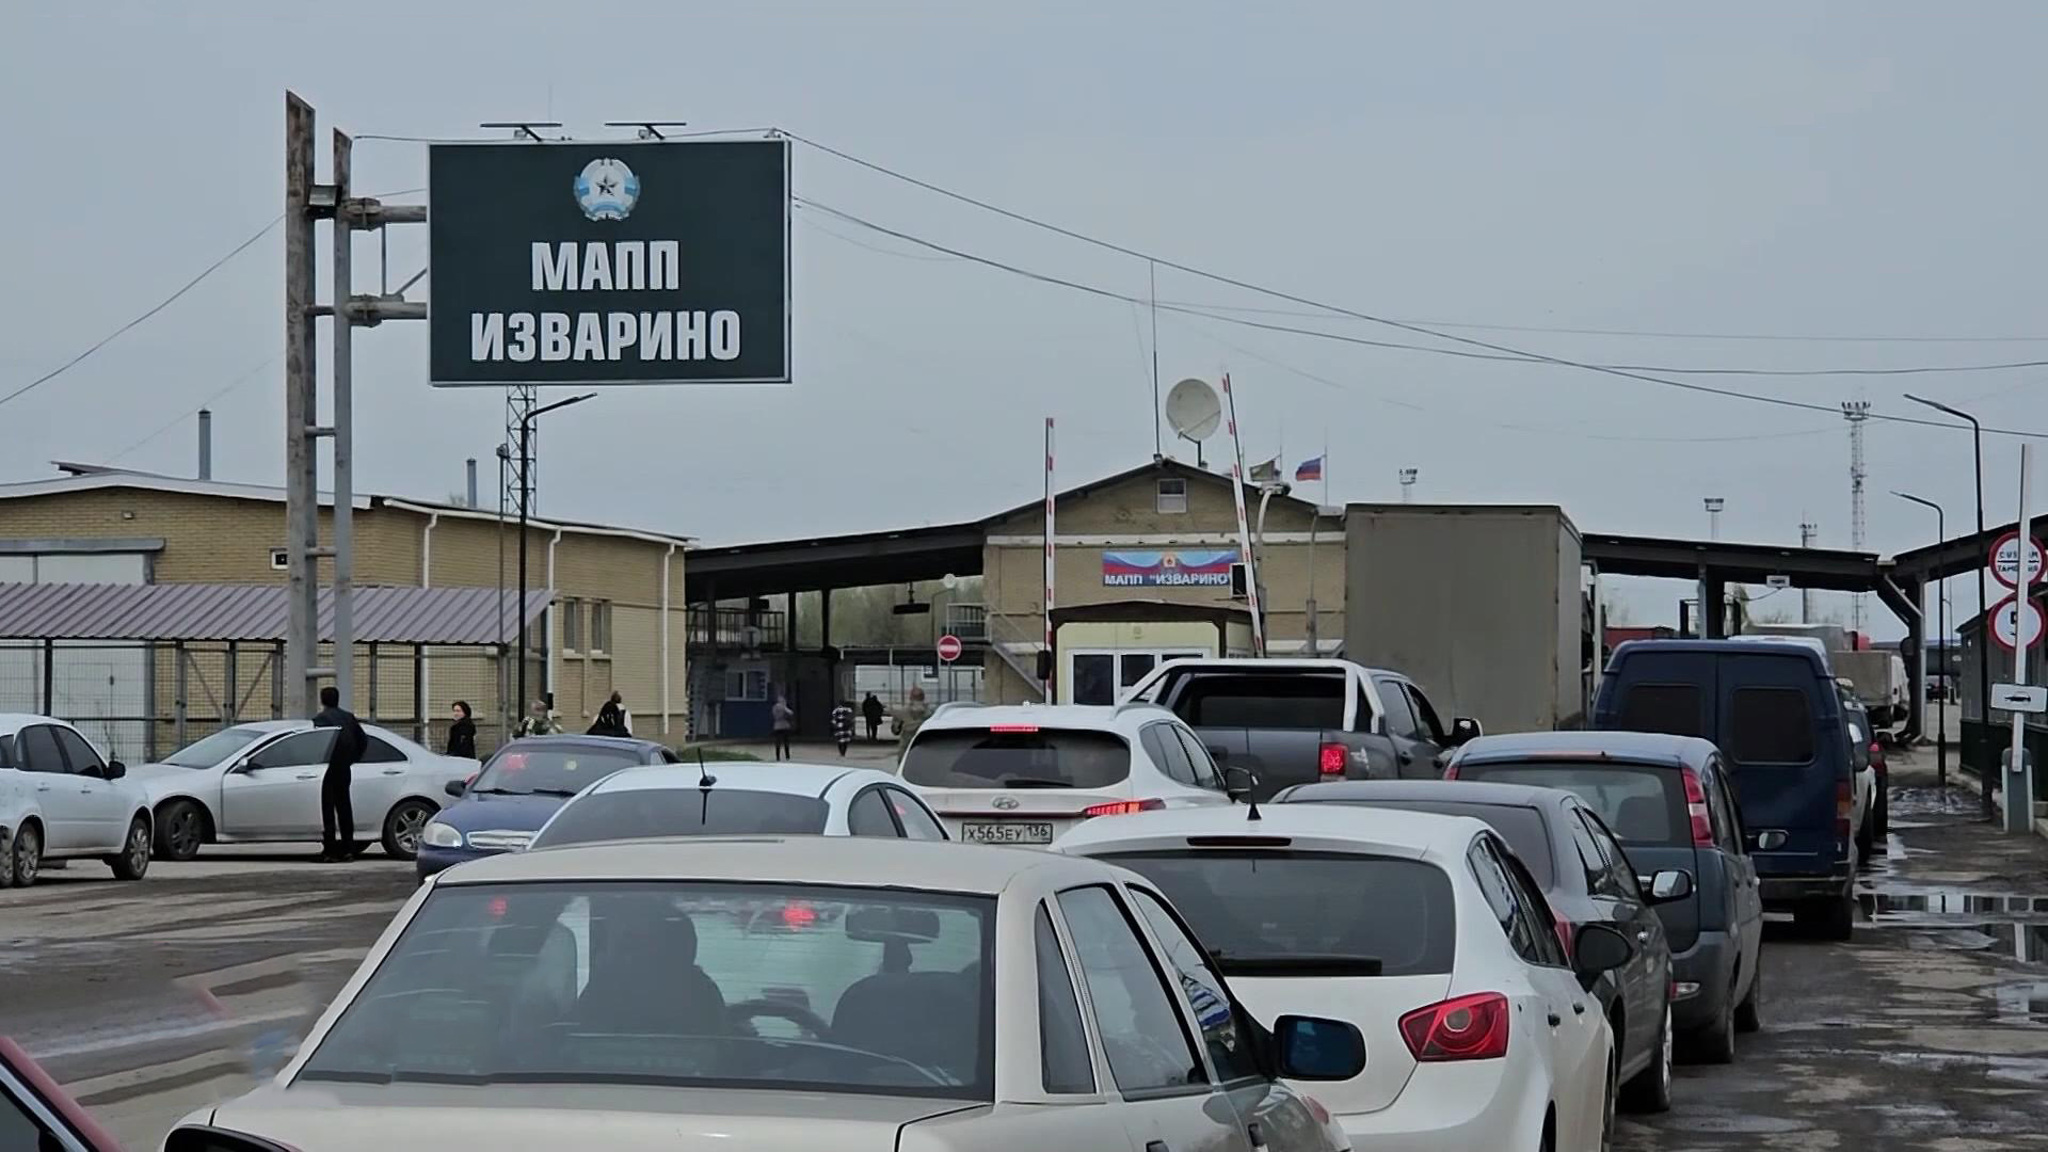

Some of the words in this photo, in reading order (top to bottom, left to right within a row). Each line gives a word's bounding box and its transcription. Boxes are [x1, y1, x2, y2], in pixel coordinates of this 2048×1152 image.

[531, 241, 680, 291] МАПП
[471, 310, 742, 361] ИЗВАРИНО
[1105, 574, 1143, 585] МАПП
